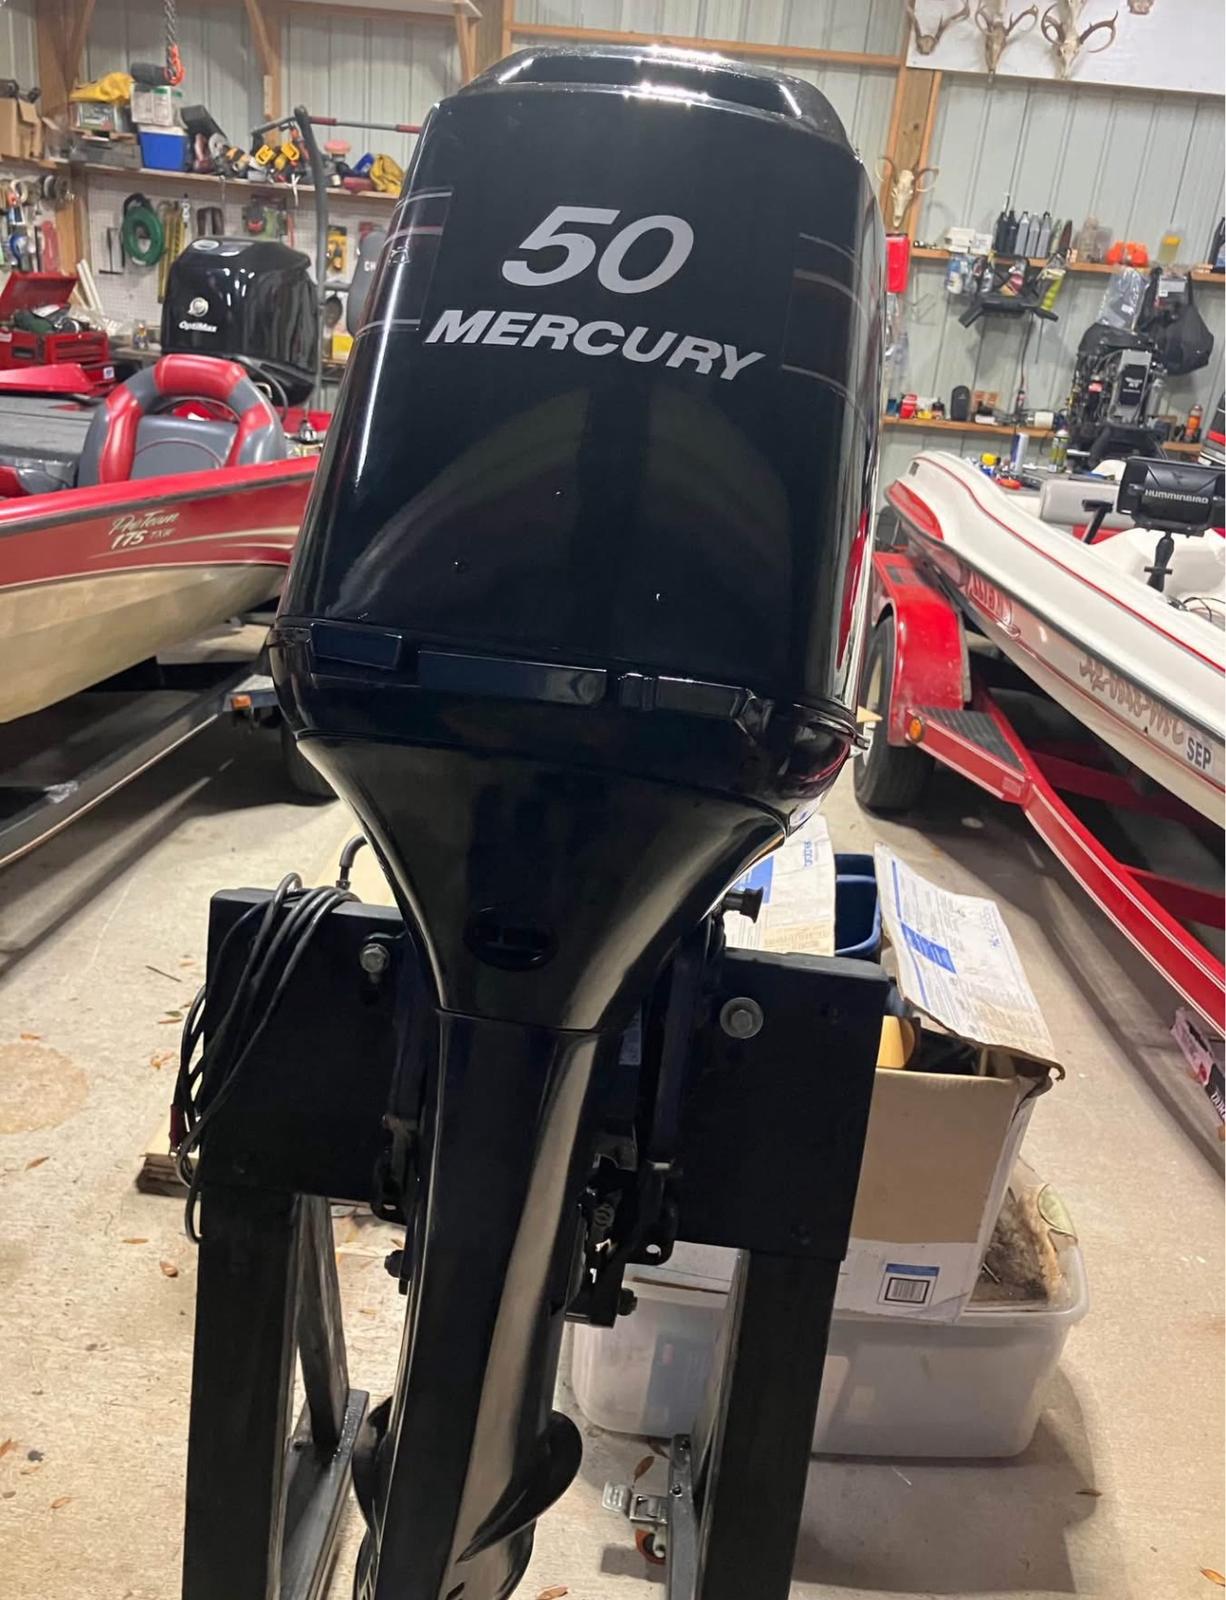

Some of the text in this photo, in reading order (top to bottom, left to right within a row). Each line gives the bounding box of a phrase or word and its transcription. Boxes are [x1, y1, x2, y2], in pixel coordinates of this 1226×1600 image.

[501, 206, 694, 294] 50
[424, 310, 765, 381] MERCURY
[1144, 489, 1209, 504] HUMMINBIRD
[112, 530, 148, 550] 175
[1186, 737, 1211, 770] SEP
